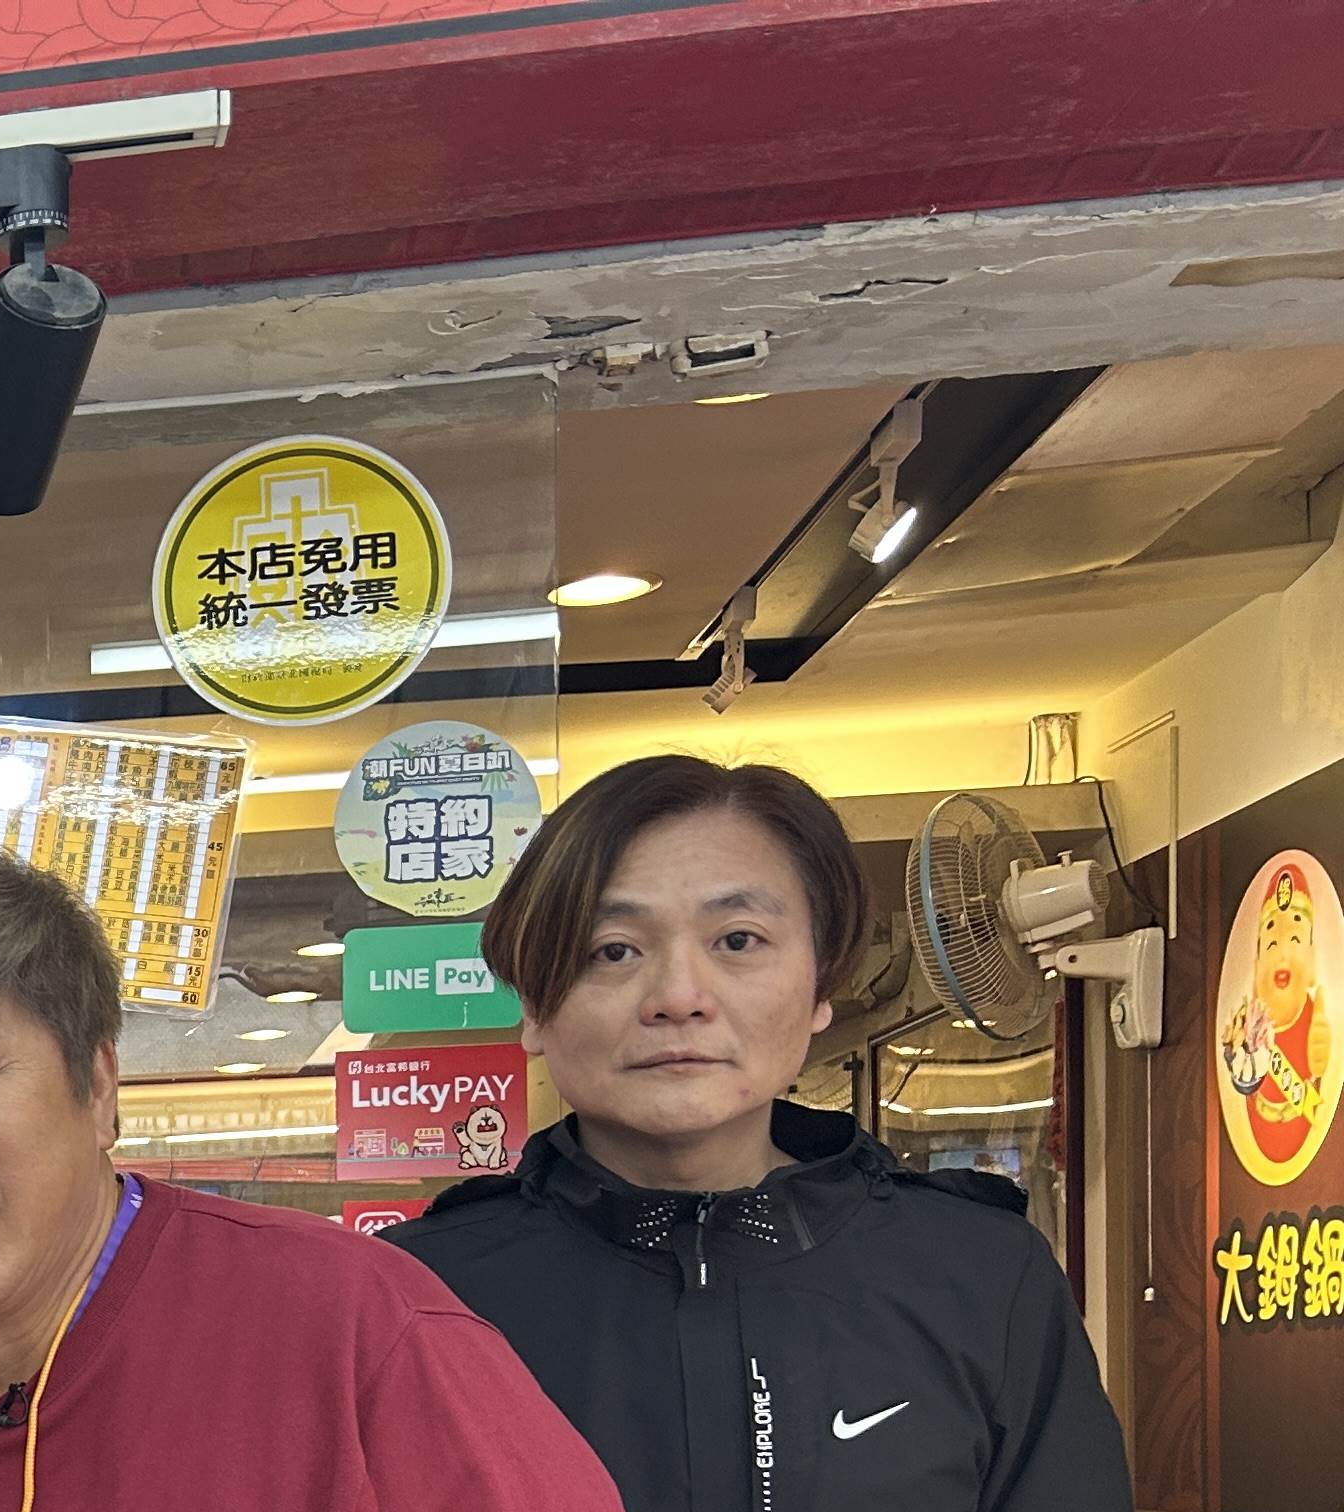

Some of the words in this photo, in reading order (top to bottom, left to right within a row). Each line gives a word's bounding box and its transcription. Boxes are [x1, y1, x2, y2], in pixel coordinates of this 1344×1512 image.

[197, 531, 397, 586] 本店免用
[197, 577, 400, 630] 統一發票
[388, 798, 490, 841] 特約
[208, 842, 223, 851] 45
[388, 838, 491, 882] 店家
[194, 928, 209, 938] 30
[187, 966, 201, 976] 15
[369, 968, 429, 991] LINE
[444, 967, 487, 987] Pay
[351, 1074, 514, 1113] LuckyPAY
